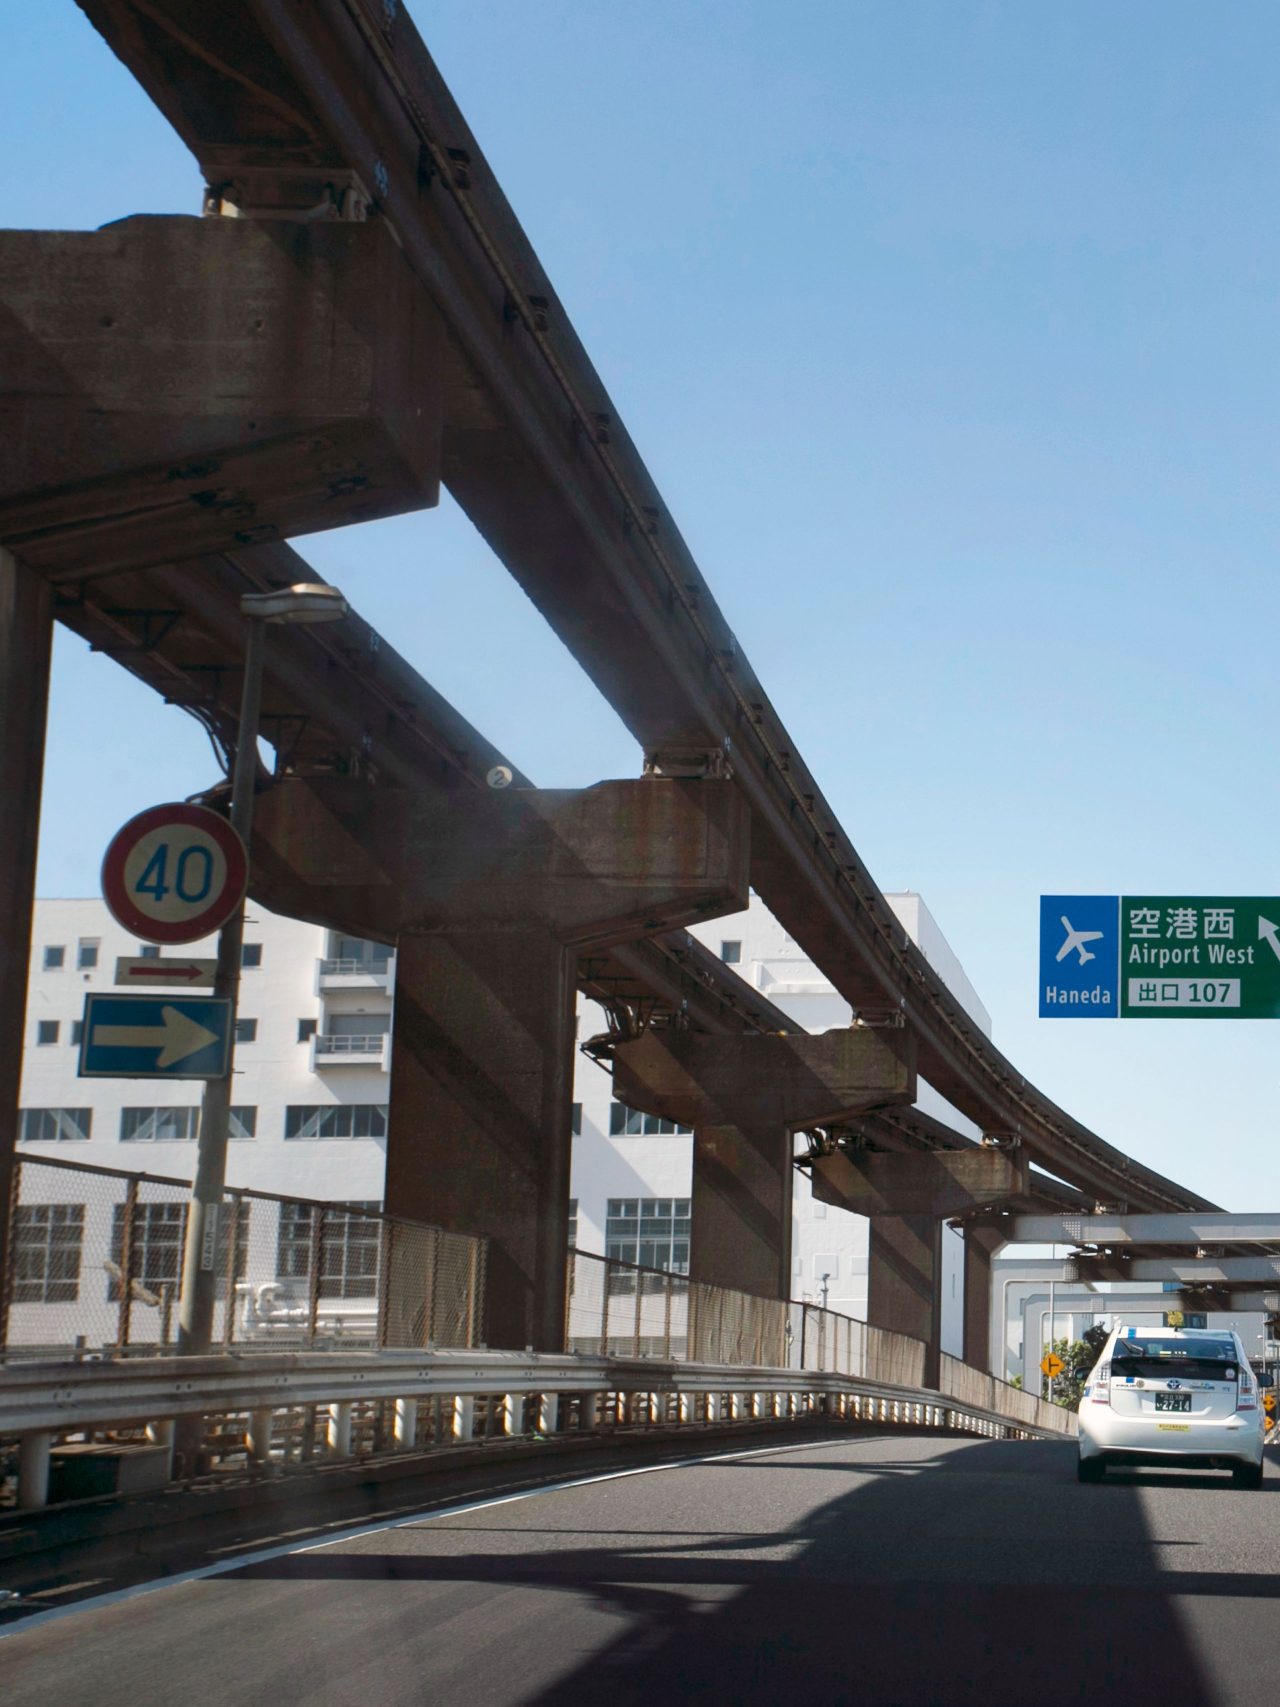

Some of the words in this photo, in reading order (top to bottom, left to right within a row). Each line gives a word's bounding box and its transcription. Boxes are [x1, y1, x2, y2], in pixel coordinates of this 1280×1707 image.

[493, 769, 506, 786] 2
[134, 843, 214, 904] 40
[1128, 907, 1236, 940] 空港西
[1128, 943, 1201, 969] Airport
[1208, 944, 1255, 965] West
[1046, 985, 1111, 1004] Haneda
[1137, 981, 1180, 1003] 出口
[1188, 982, 1232, 1004] 107
[1162, 1400, 1190, 1412] 27-14
